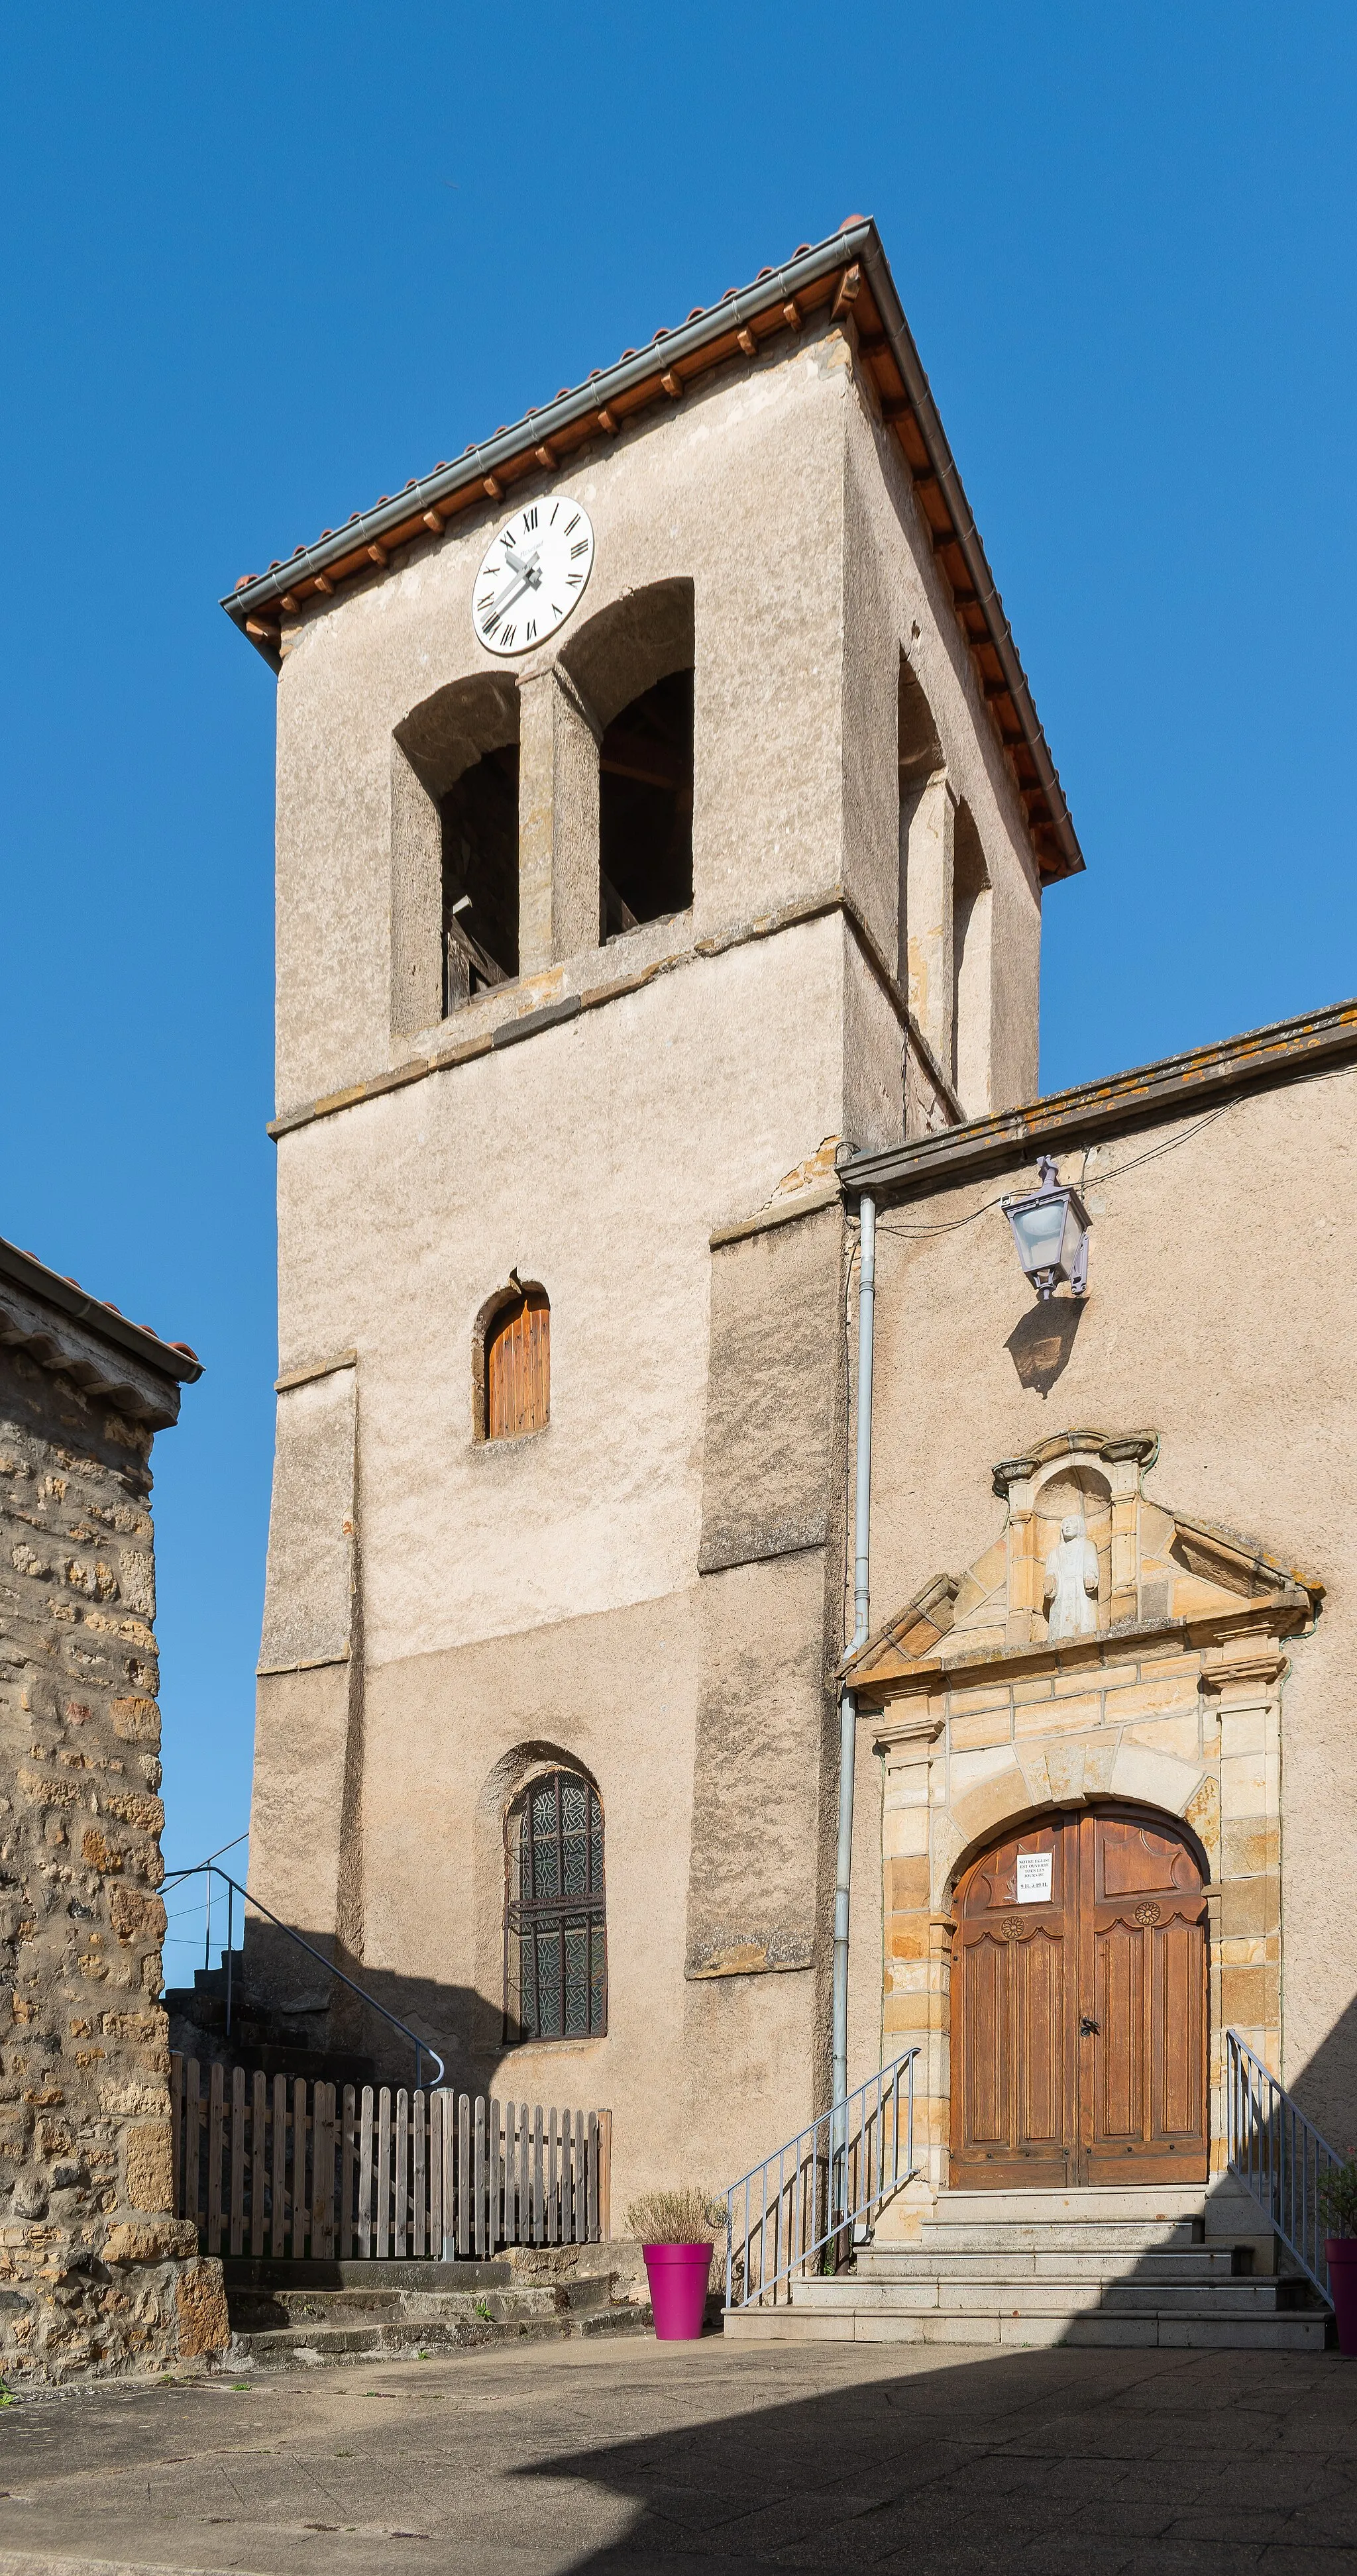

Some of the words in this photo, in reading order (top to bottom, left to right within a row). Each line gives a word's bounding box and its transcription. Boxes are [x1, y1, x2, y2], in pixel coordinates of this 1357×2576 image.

[523, 506, 538, 535] XII
[564, 513, 581, 537] II
[500, 530, 516, 552] XI
[570, 539, 588, 560] III
[483, 566, 500, 576] X
[565, 574, 583, 590] IV
[477, 592, 494, 611] IX
[551, 603, 563, 620] V
[500, 624, 517, 646] VII
[527, 619, 537, 641] VI
